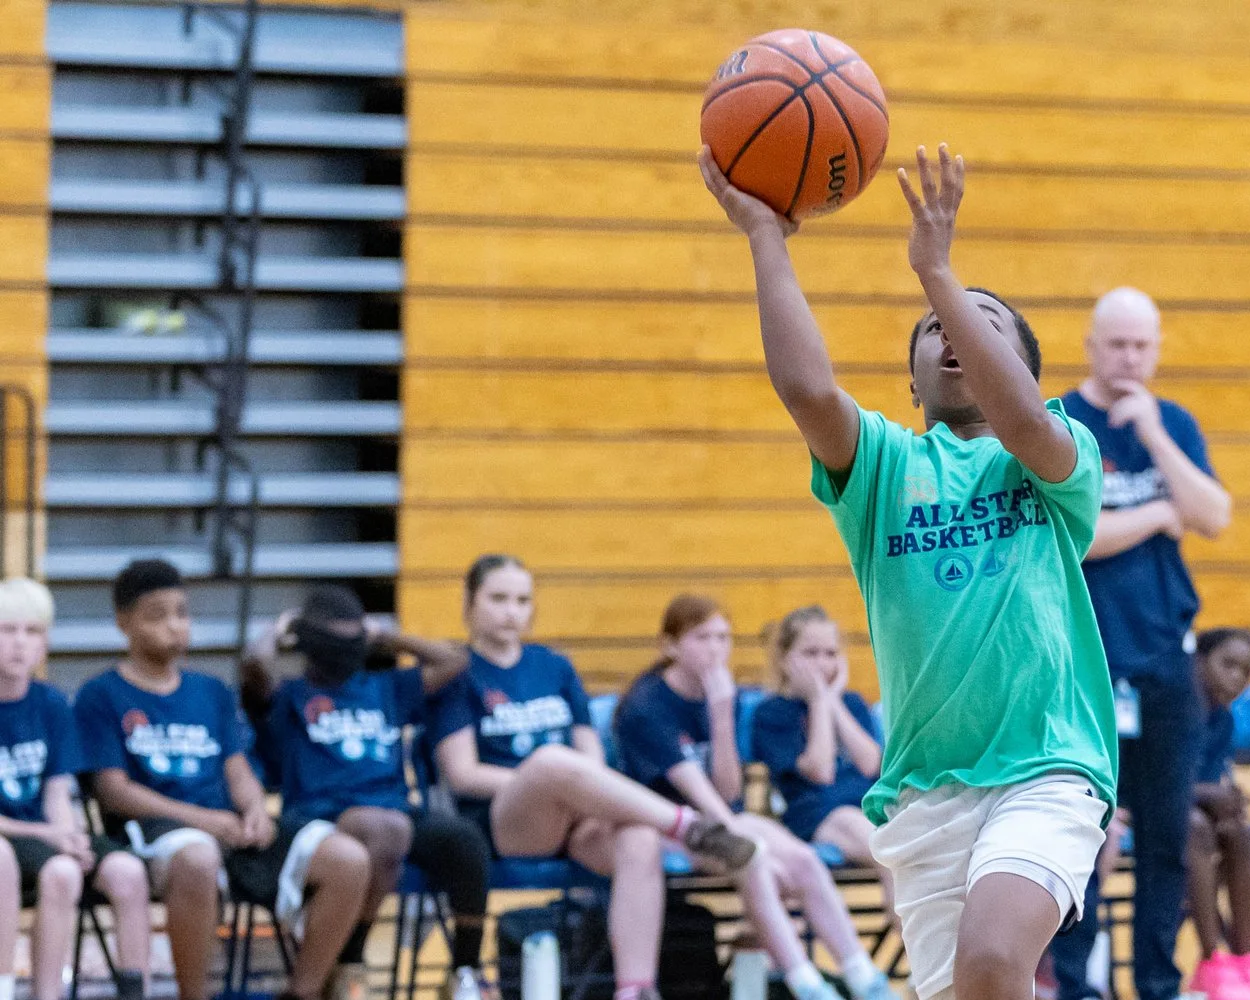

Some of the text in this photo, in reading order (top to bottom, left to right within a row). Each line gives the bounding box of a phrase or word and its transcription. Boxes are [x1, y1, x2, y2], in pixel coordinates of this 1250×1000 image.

[906, 478, 1035, 528] ALL STAR
[886, 504, 1048, 557] BASKETBALL
